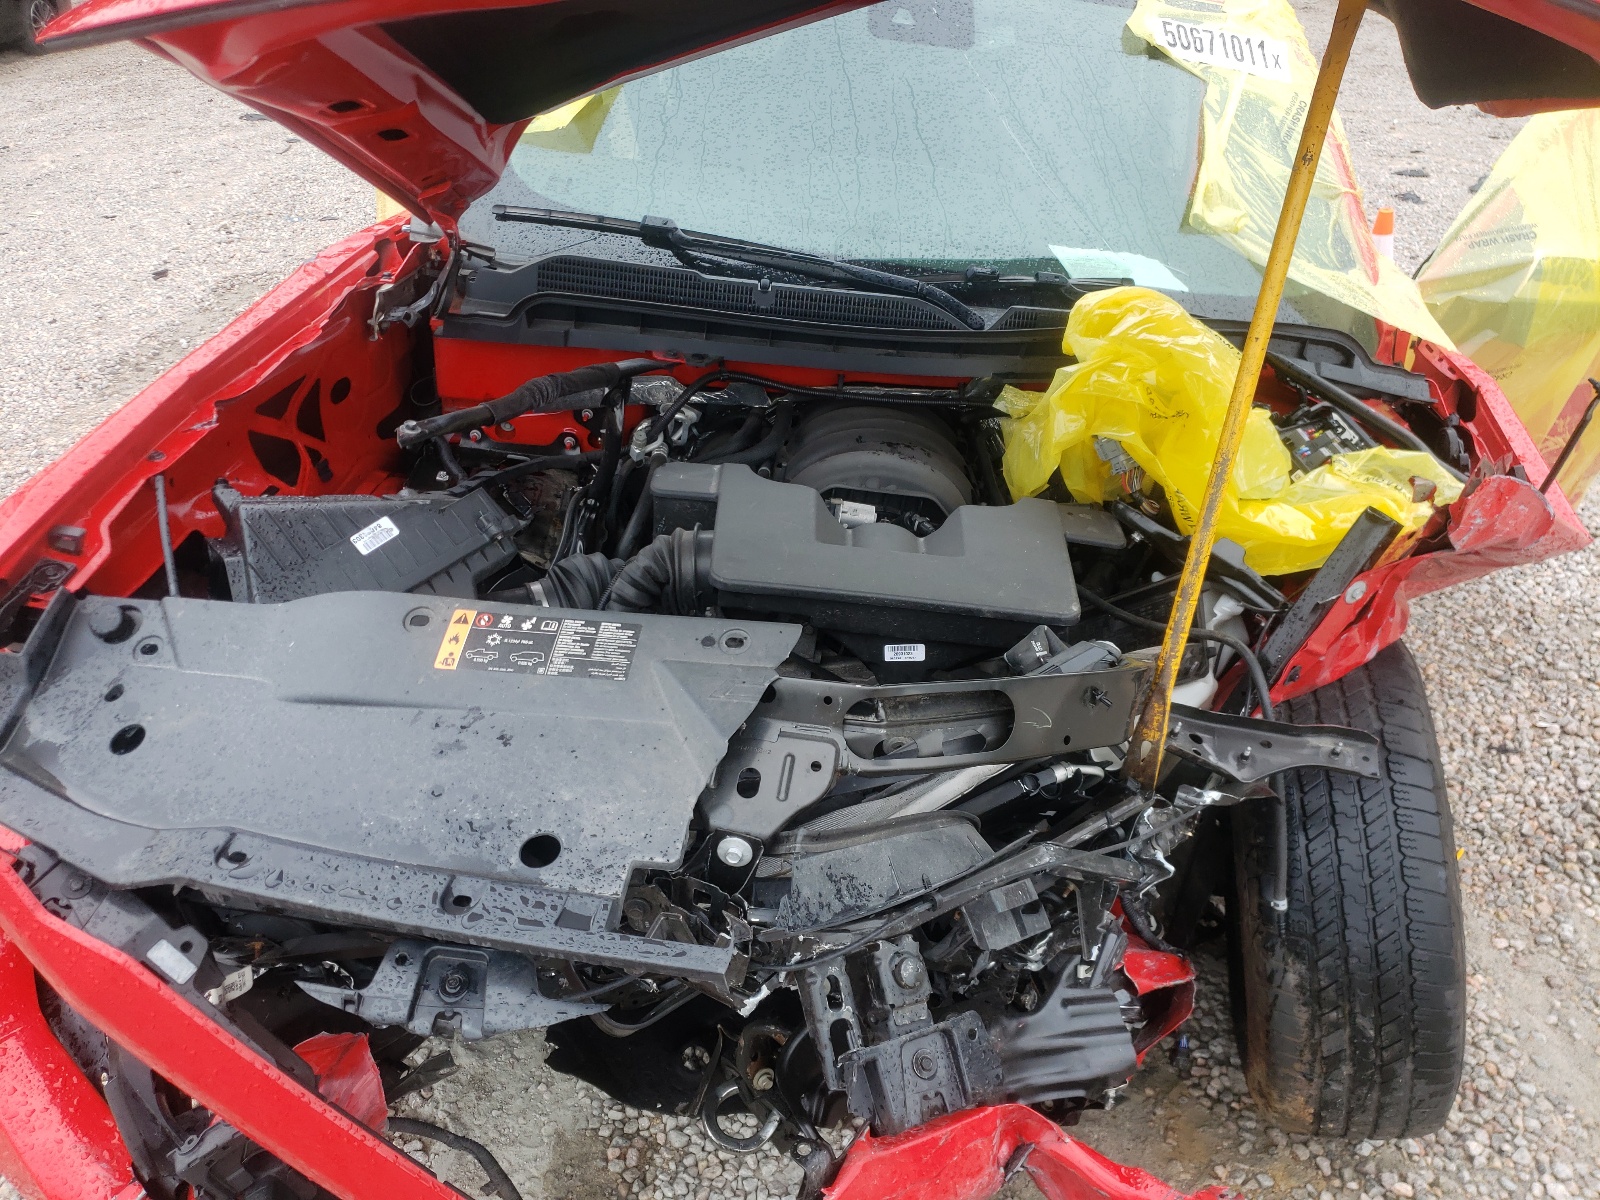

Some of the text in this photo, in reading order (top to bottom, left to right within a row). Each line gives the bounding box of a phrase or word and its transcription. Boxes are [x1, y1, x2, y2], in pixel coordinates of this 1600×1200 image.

[1161, 20, 1269, 69] 50671011
[1289, 100, 1308, 128] CRASH
[1468, 231, 1537, 249] CRASH WRAP
